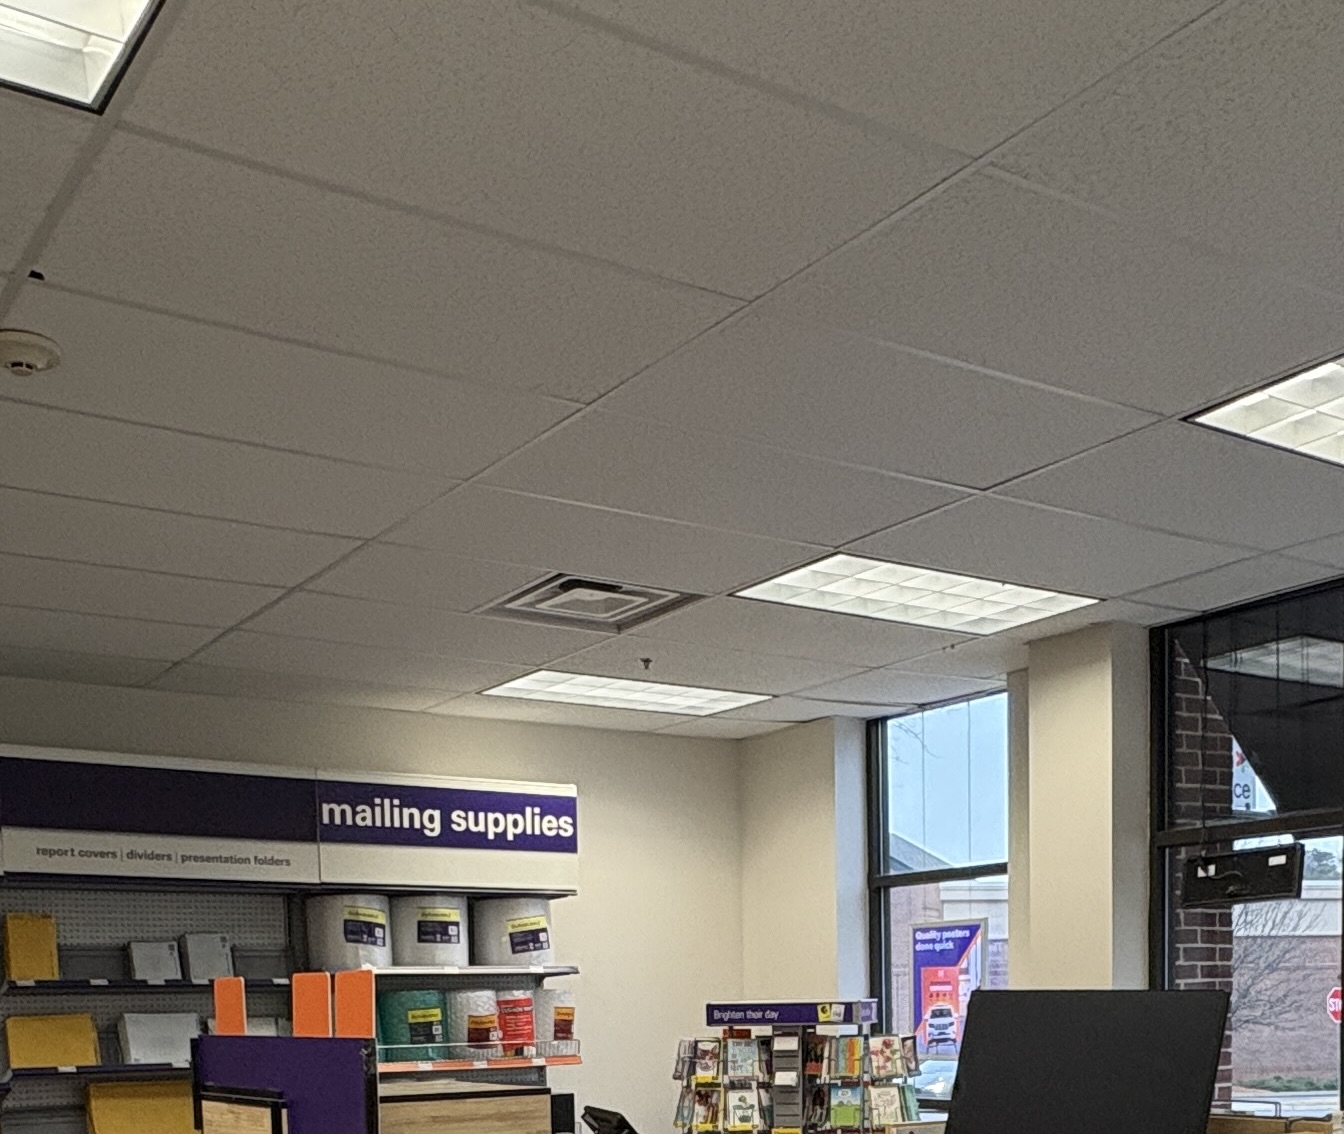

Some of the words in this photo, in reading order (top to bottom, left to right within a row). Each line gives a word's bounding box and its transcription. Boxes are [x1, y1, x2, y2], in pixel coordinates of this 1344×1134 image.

[321, 797, 443, 837] mailing
[450, 804, 575, 842] supplies
[35, 845, 76, 862] report
[78, 848, 119, 862] covers
[126, 849, 174, 864] dividers
[181, 853, 252, 868] presentation
[254, 855, 293, 869] folders
[915, 930, 941, 941] Quality
[942, 929, 970, 939] posters
[915, 942, 933, 951] done
[934, 941, 954, 952] quick
[713, 1010, 745, 1021] Brighten
[765, 1010, 779, 1020] day
